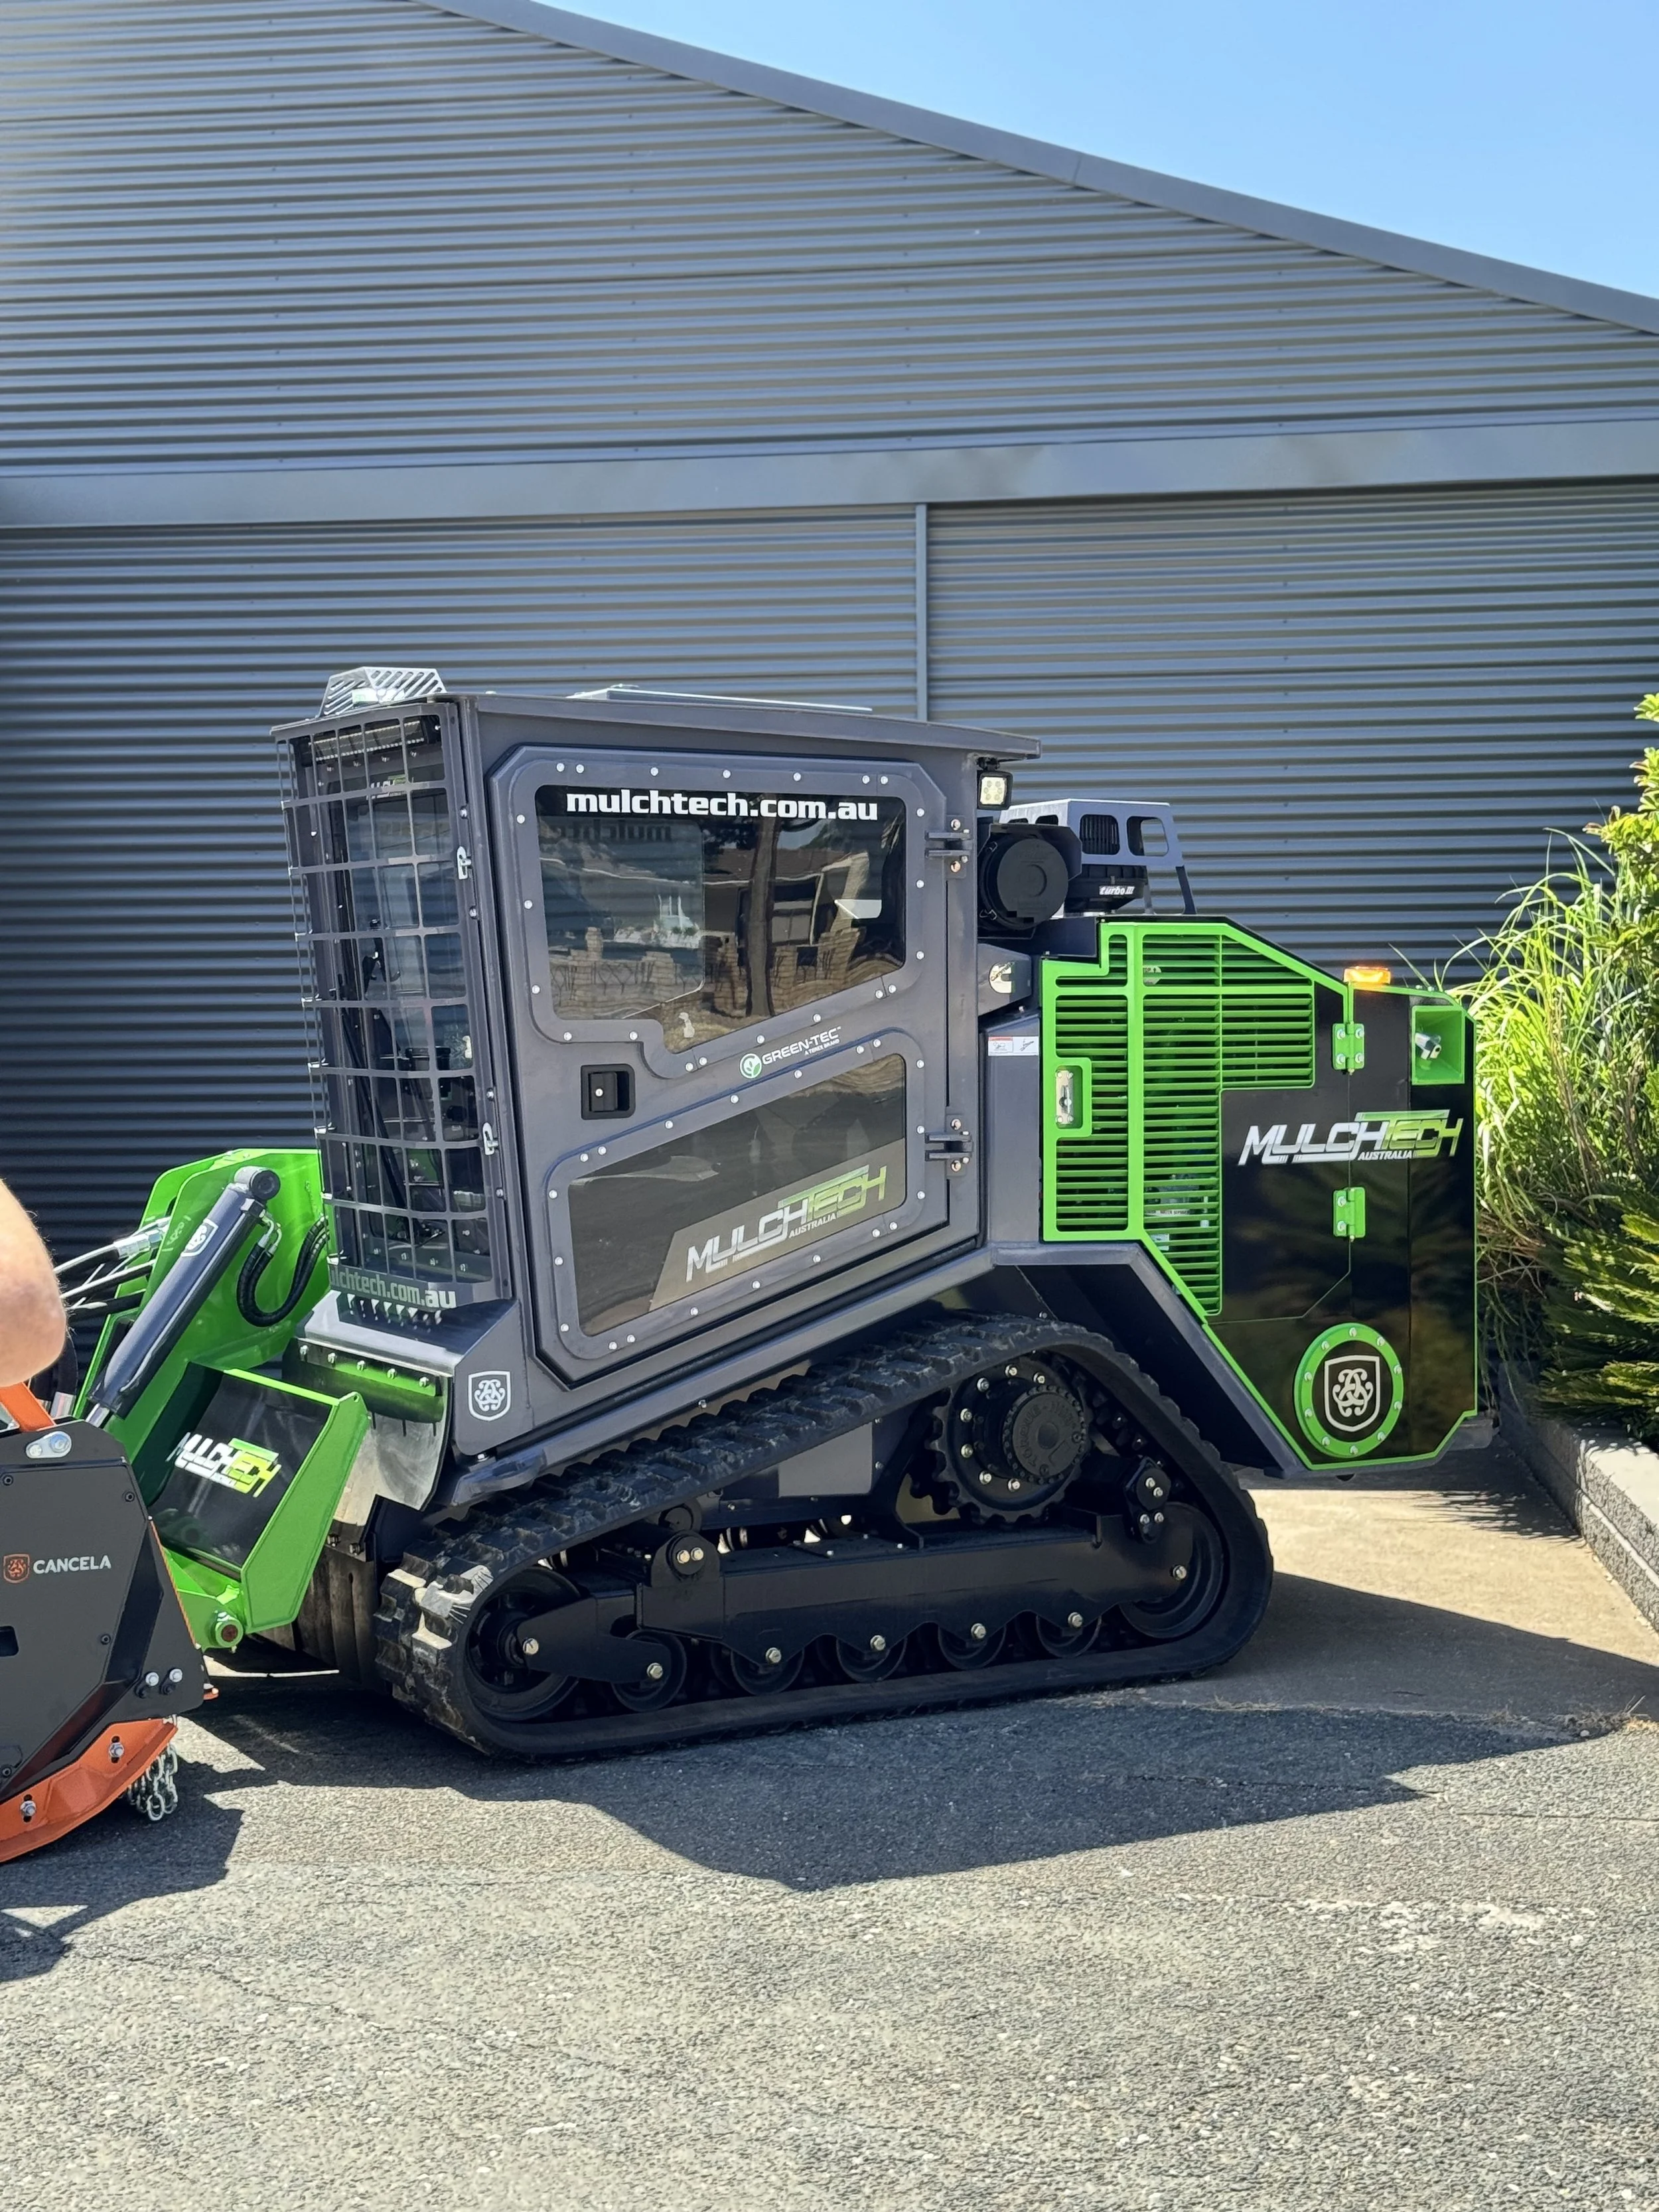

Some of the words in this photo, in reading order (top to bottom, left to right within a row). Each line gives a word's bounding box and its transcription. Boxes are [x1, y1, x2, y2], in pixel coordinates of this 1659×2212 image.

[566, 789, 878, 820] mulchtech.com.au
[1099, 885, 1125, 895] turbo
[762, 1027, 839, 1065] GREEN-TEC
[1238, 1109, 1464, 1166] MULCHTECH
[1357, 1150, 1413, 1161] AUSTRALIA
[685, 1165, 887, 1282] MULCHTECH
[788, 1212, 837, 1239] AUSTRALIA
[33, 1555, 111, 1574] CANCELA
